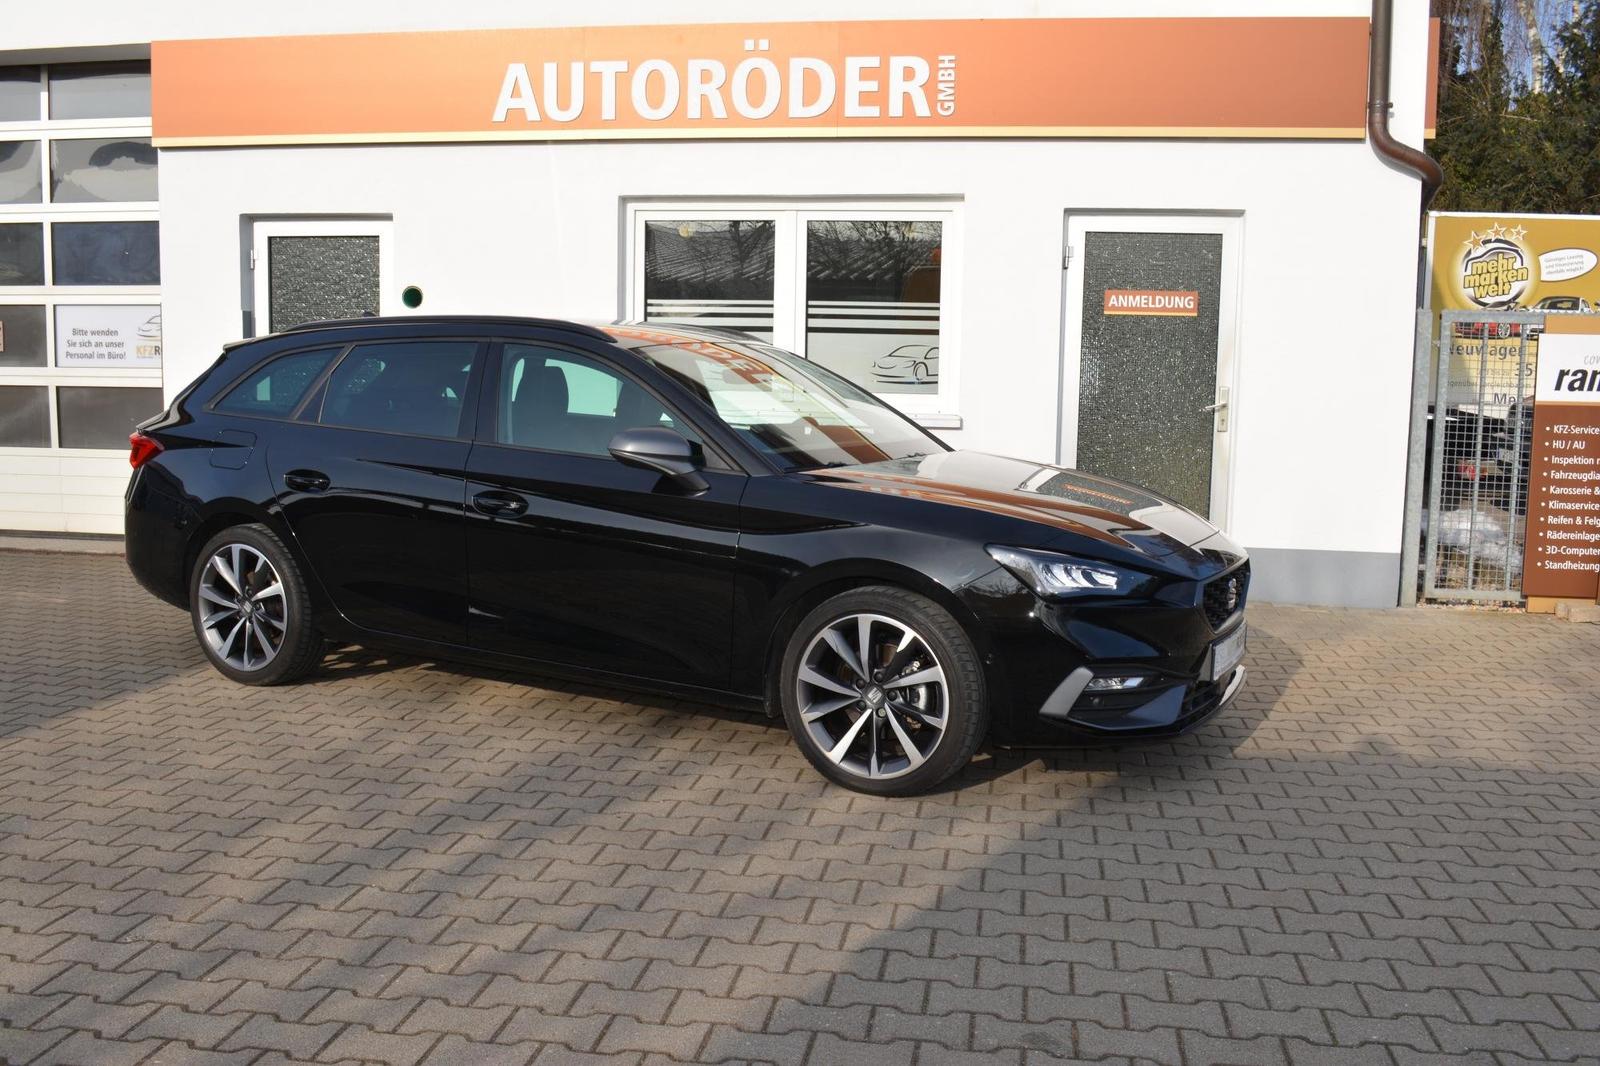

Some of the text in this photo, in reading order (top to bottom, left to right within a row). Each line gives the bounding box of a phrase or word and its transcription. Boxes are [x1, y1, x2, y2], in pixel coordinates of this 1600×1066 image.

[491, 38, 932, 123] AUTORÖDER
[936, 54, 957, 117] GMBH
[1471, 253, 1517, 276] mehr
[1463, 267, 1529, 289] marken
[1473, 280, 1512, 299] welt
[1108, 295, 1195, 309] ANMELDUNG
[71, 328, 119, 337] Bitte wenden
[66, 340, 77, 348] Sie
[78, 340, 93, 348] sich
[105, 341, 125, 349] unser
[65, 351, 127, 360] Personal im Büro!
[1553, 424, 1600, 435] KFZ-Service
[1552, 440, 1566, 449] HU
[1572, 440, 1586, 450] AU
[1551, 455, 1595, 466] Inspektion
[1549, 485, 1592, 495] Karosserie
[1548, 500, 1600, 511] Klimaservice
[1547, 515, 1574, 525] Reifen
[1575, 515, 1583, 525] &
[1544, 560, 1600, 573] Standheizung
